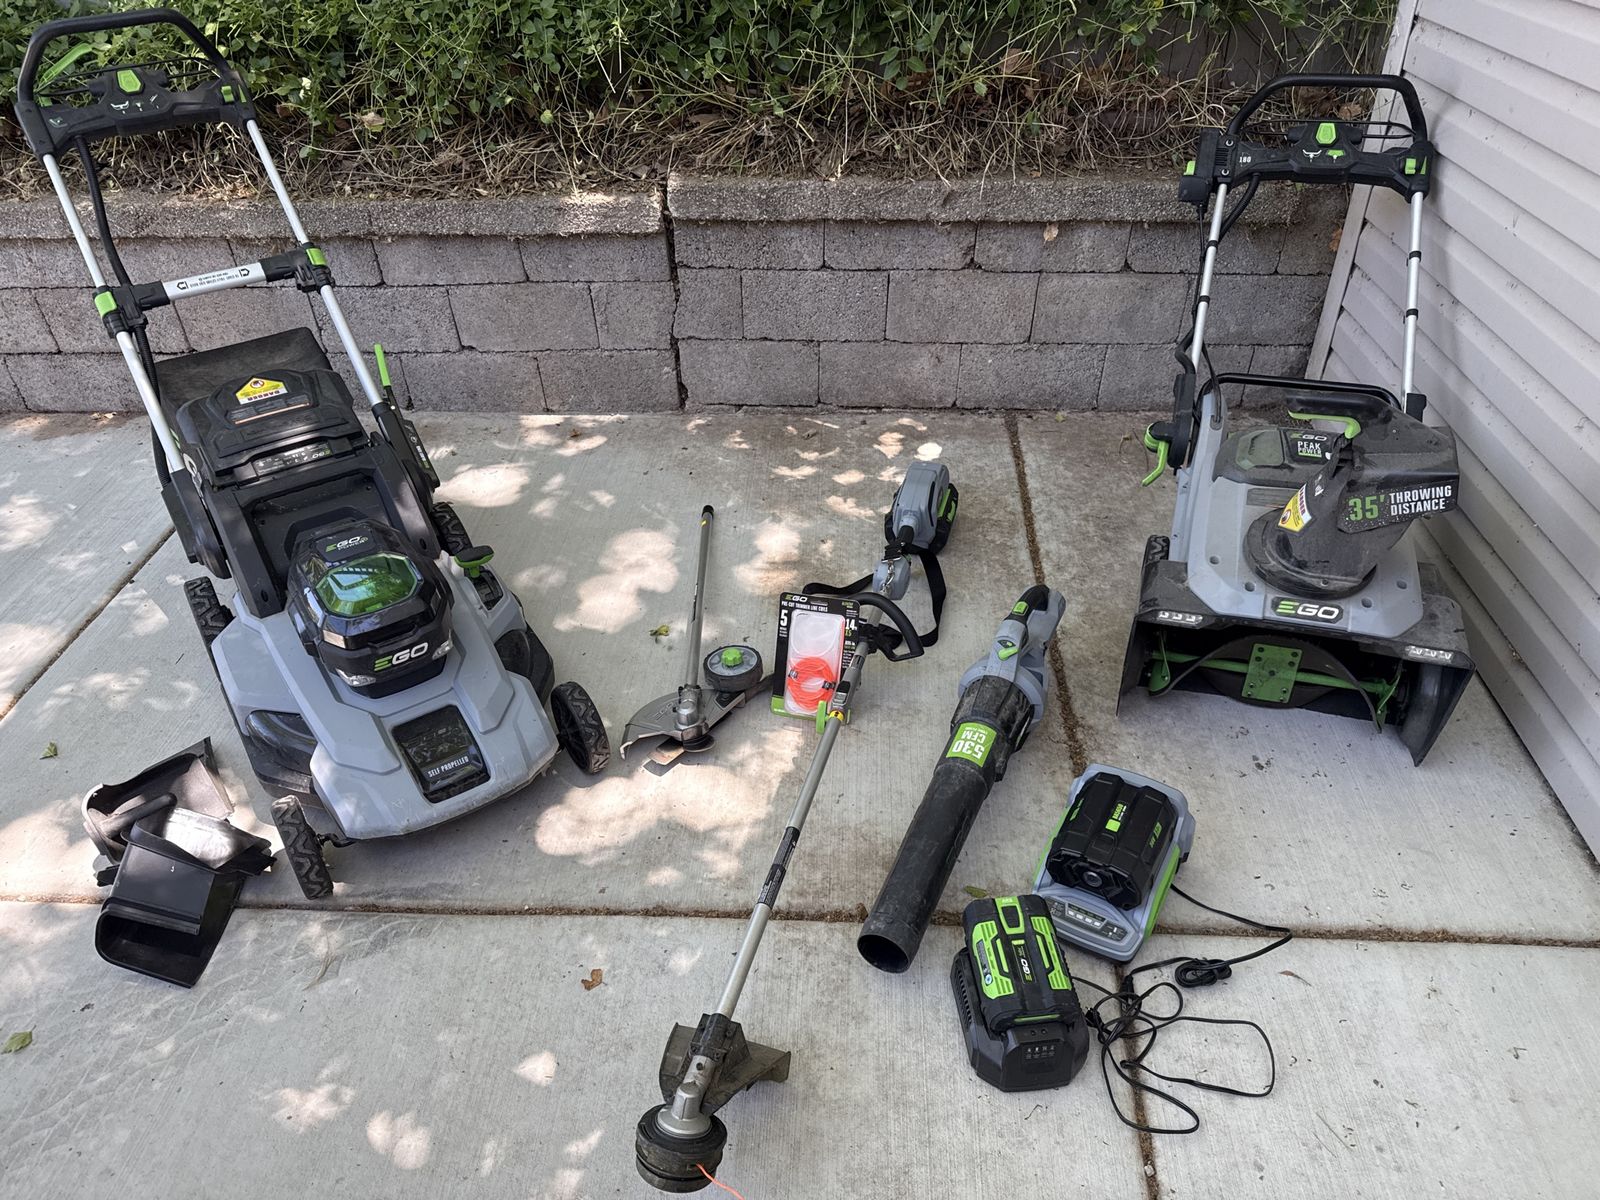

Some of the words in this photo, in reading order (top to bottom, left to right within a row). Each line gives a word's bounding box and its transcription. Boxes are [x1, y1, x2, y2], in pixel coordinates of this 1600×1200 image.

[1290, 432, 1327, 441] EGO
[1297, 441, 1321, 449] PEAK
[1389, 485, 1452, 504] THROWING
[1390, 498, 1446, 516] DISTANCE
[325, 536, 363, 552] EGO
[785, 594, 808, 602] EGO
[780, 609, 788, 626] 5
[1276, 600, 1340, 620] EGO
[374, 642, 429, 672] EGO
[961, 730, 986, 744] CFM
[952, 739, 985, 759] 530
[427, 767, 441, 778] SELF
[440, 755, 469, 772] PROPELLED
[1020, 958, 1033, 982] EGO
